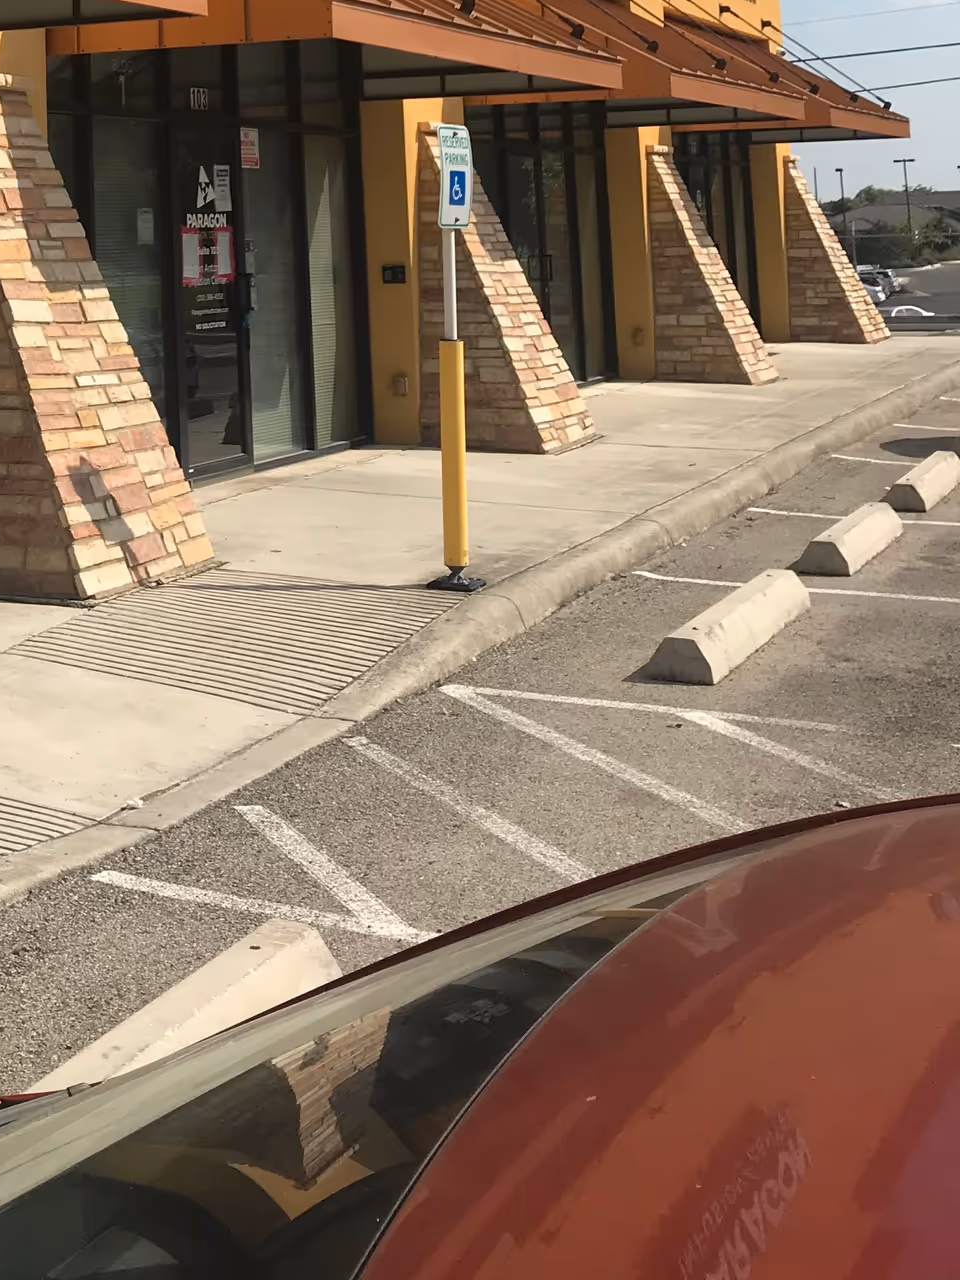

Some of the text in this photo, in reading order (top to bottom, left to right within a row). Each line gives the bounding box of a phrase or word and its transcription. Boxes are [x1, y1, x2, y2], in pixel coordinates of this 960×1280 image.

[191, 87, 208, 110] 103
[442, 135, 469, 149] RESERVED
[445, 152, 468, 166] PARKING
[187, 213, 227, 228] PARAGON
